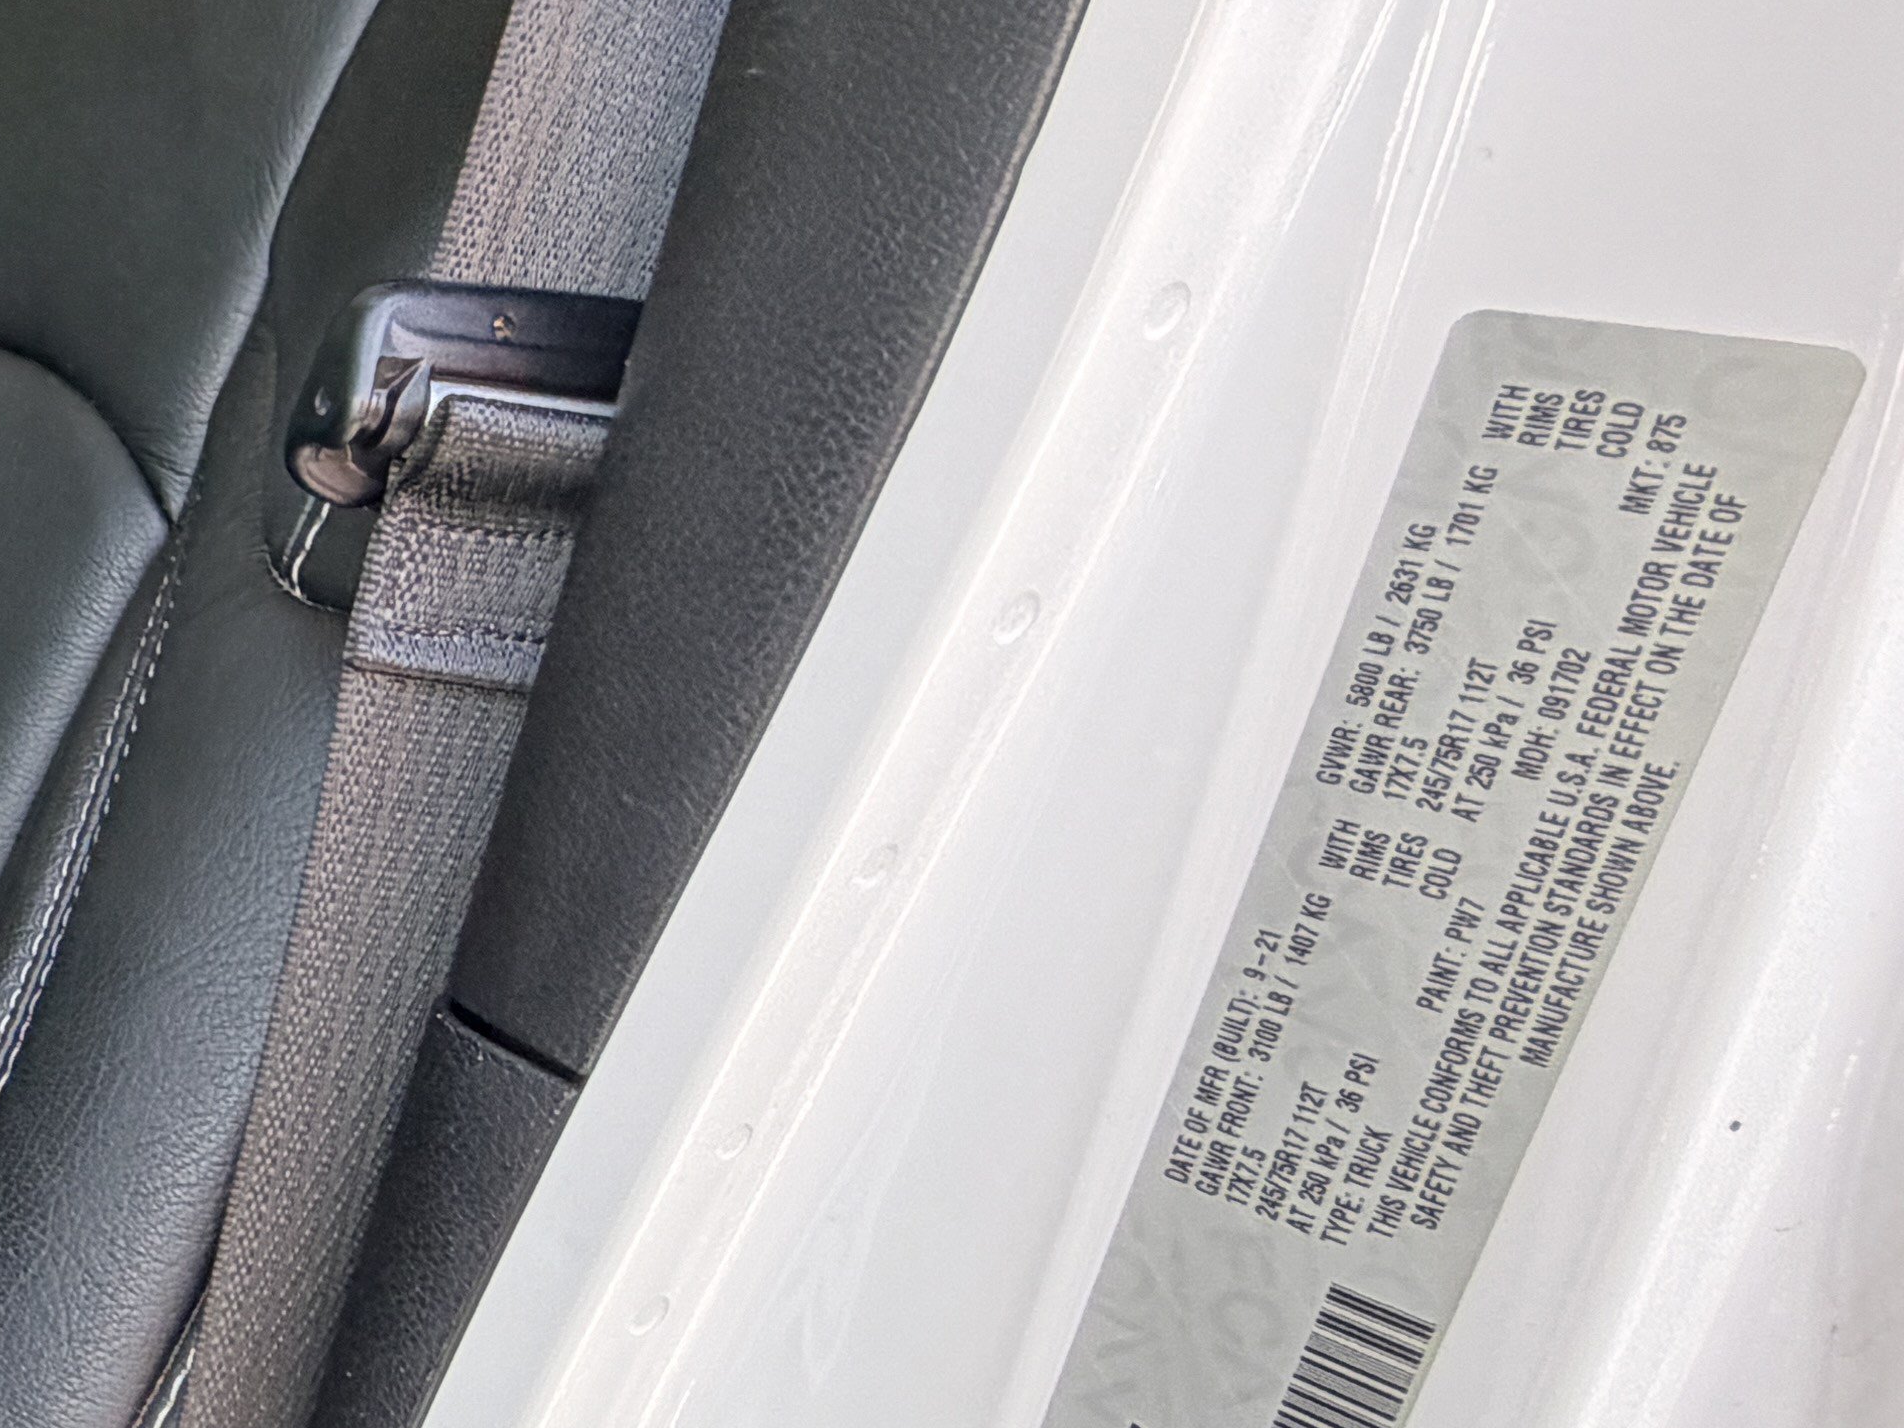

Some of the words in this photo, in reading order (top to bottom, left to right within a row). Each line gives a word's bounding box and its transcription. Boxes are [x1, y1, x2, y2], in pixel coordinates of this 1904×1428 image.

[1481, 383, 1531, 441] WITH
[1594, 399, 1646, 459] COLD
[1643, 411, 1689, 453] 875
[1462, 464, 1499, 493] KG
[1618, 456, 1671, 515] MKT:
[1442, 500, 1485, 548] 1701
[1650, 461, 1719, 554] VEHICLE
[1706, 492, 1750, 525] OF
[1402, 521, 1438, 552] KG
[1679, 527, 1735, 588] DATE
[1379, 734, 1430, 804] 17X7.5
[1517, 391, 1566, 446] RIMS
[1382, 557, 1424, 605] 2631
[1413, 708, 1478, 813] 245/75R17
[1454, 656, 1500, 706] 112T
[1554, 388, 1607, 453] TIRES
[1421, 575, 1456, 602] LB
[1616, 559, 1678, 637] MOTOR
[1401, 606, 1444, 655] 3750
[1516, 617, 1557, 654] PSI
[1658, 592, 1707, 639] THE
[1363, 630, 1396, 657] LB
[1642, 641, 1686, 676] ON
[1344, 660, 1385, 708] 5800
[1372, 665, 1421, 729] REAR:
[1504, 658, 1541, 686] 36
[1575, 639, 1644, 739] FEDERAL
[1478, 709, 1520, 749] kPa
[1510, 722, 1560, 781] MDH:
[1535, 645, 1592, 721] 091702
[1607, 679, 1669, 760] EFFECT
[1314, 717, 1363, 786] GVWR:
[1347, 732, 1395, 795] GAWR
[1462, 751, 1503, 790] 250
[1546, 740, 1601, 808] U.S.A.
[1595, 762, 1634, 788] IN
[1449, 792, 1486, 823] AT
[1318, 817, 1360, 871] WITH
[1540, 790, 1621, 918] STANDARDS
[1417, 845, 1463, 901] COLD
[1493, 809, 1571, 934] APPLICABLE
[1300, 891, 1332, 920] KG
[1518, 916, 1609, 1068] MANUFACTURE
[1583, 835, 1645, 916] SHOWN
[1619, 754, 1681, 835] ABOVE.
[1282, 922, 1320, 967] 1407
[1415, 944, 1467, 1013] PAINT:
[1443, 895, 1487, 944] PW7
[1476, 933, 1518, 975] ALL
[1264, 990, 1294, 1016] LB
[1463, 975, 1500, 1006] TO
[1487, 917, 1566, 1044] PREVENTION
[1210, 987, 1264, 1064] (BUILT):
[1223, 1144, 1267, 1209] 17X7.5
[1349, 828, 1392, 881] RIMS
[1246, 1017, 1283, 1063] 3100
[1253, 1126, 1310, 1221] 245/75R17
[1289, 1080, 1328, 1128] 112T
[1382, 830, 1429, 891] TIRES
[1193, 1062, 1230, 1106] MFR
[1343, 1051, 1379, 1087] PSI
[1418, 1006, 1487, 1116] CONFORMS
[1459, 1045, 1511, 1111] THEFT
[1182, 1106, 1213, 1136] OF
[1216, 1067, 1264, 1139] FRONT:
[1333, 1086, 1365, 1114] 36
[1310, 1131, 1346, 1170] kPa
[1385, 1113, 1441, 1195] VEHICLE
[1440, 1110, 1483, 1156] AND
[1163, 1133, 1203, 1185] DATE
[1193, 1138, 1236, 1197] GAWR
[1296, 1168, 1331, 1206] 250
[1319, 1188, 1365, 1249] TYPE:
[1343, 1124, 1392, 1191] TRUCK
[1408, 1154, 1463, 1231] SAFETY
[1284, 1204, 1317, 1234] AT
[1366, 1192, 1408, 1241] THIS
